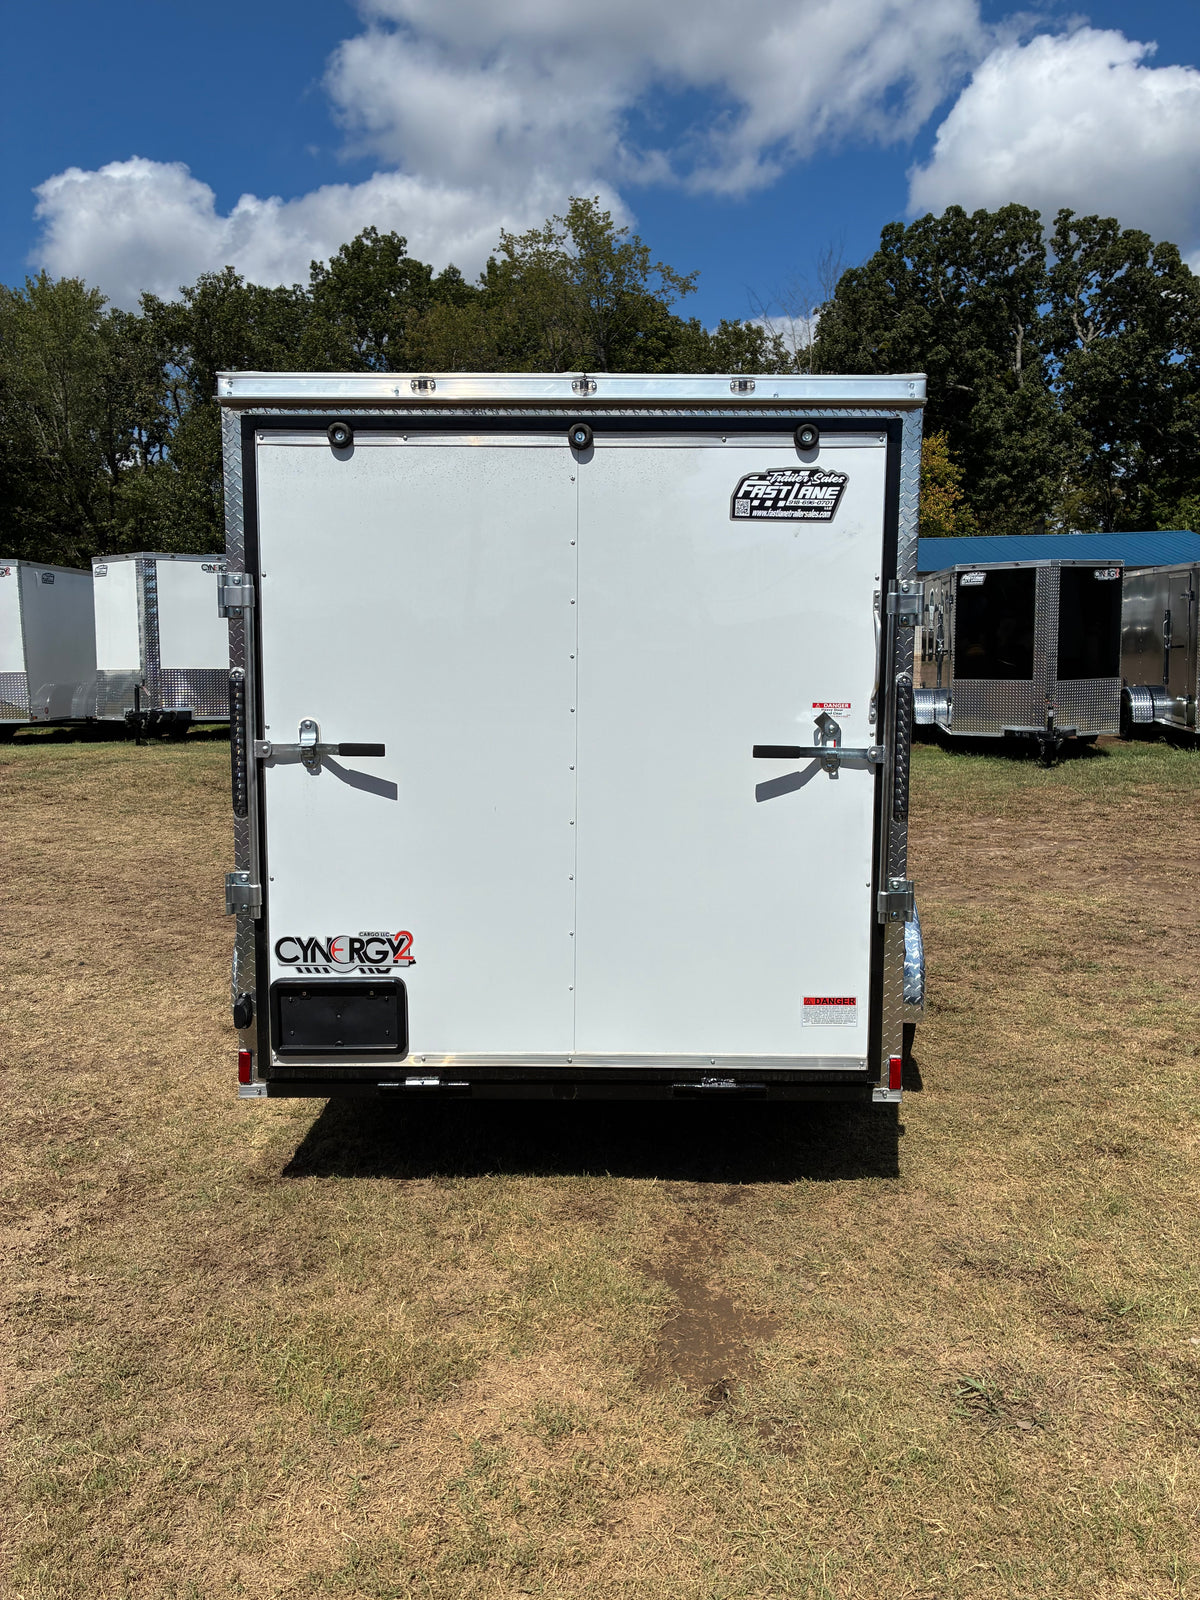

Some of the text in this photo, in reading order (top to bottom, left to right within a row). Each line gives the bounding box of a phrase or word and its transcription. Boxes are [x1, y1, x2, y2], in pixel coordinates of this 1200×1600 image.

[769, 471, 846, 484] Trailer Sales
[751, 508, 832, 518] www.fastlanetrailersales.com
[815, 997, 856, 1005] DANGER
